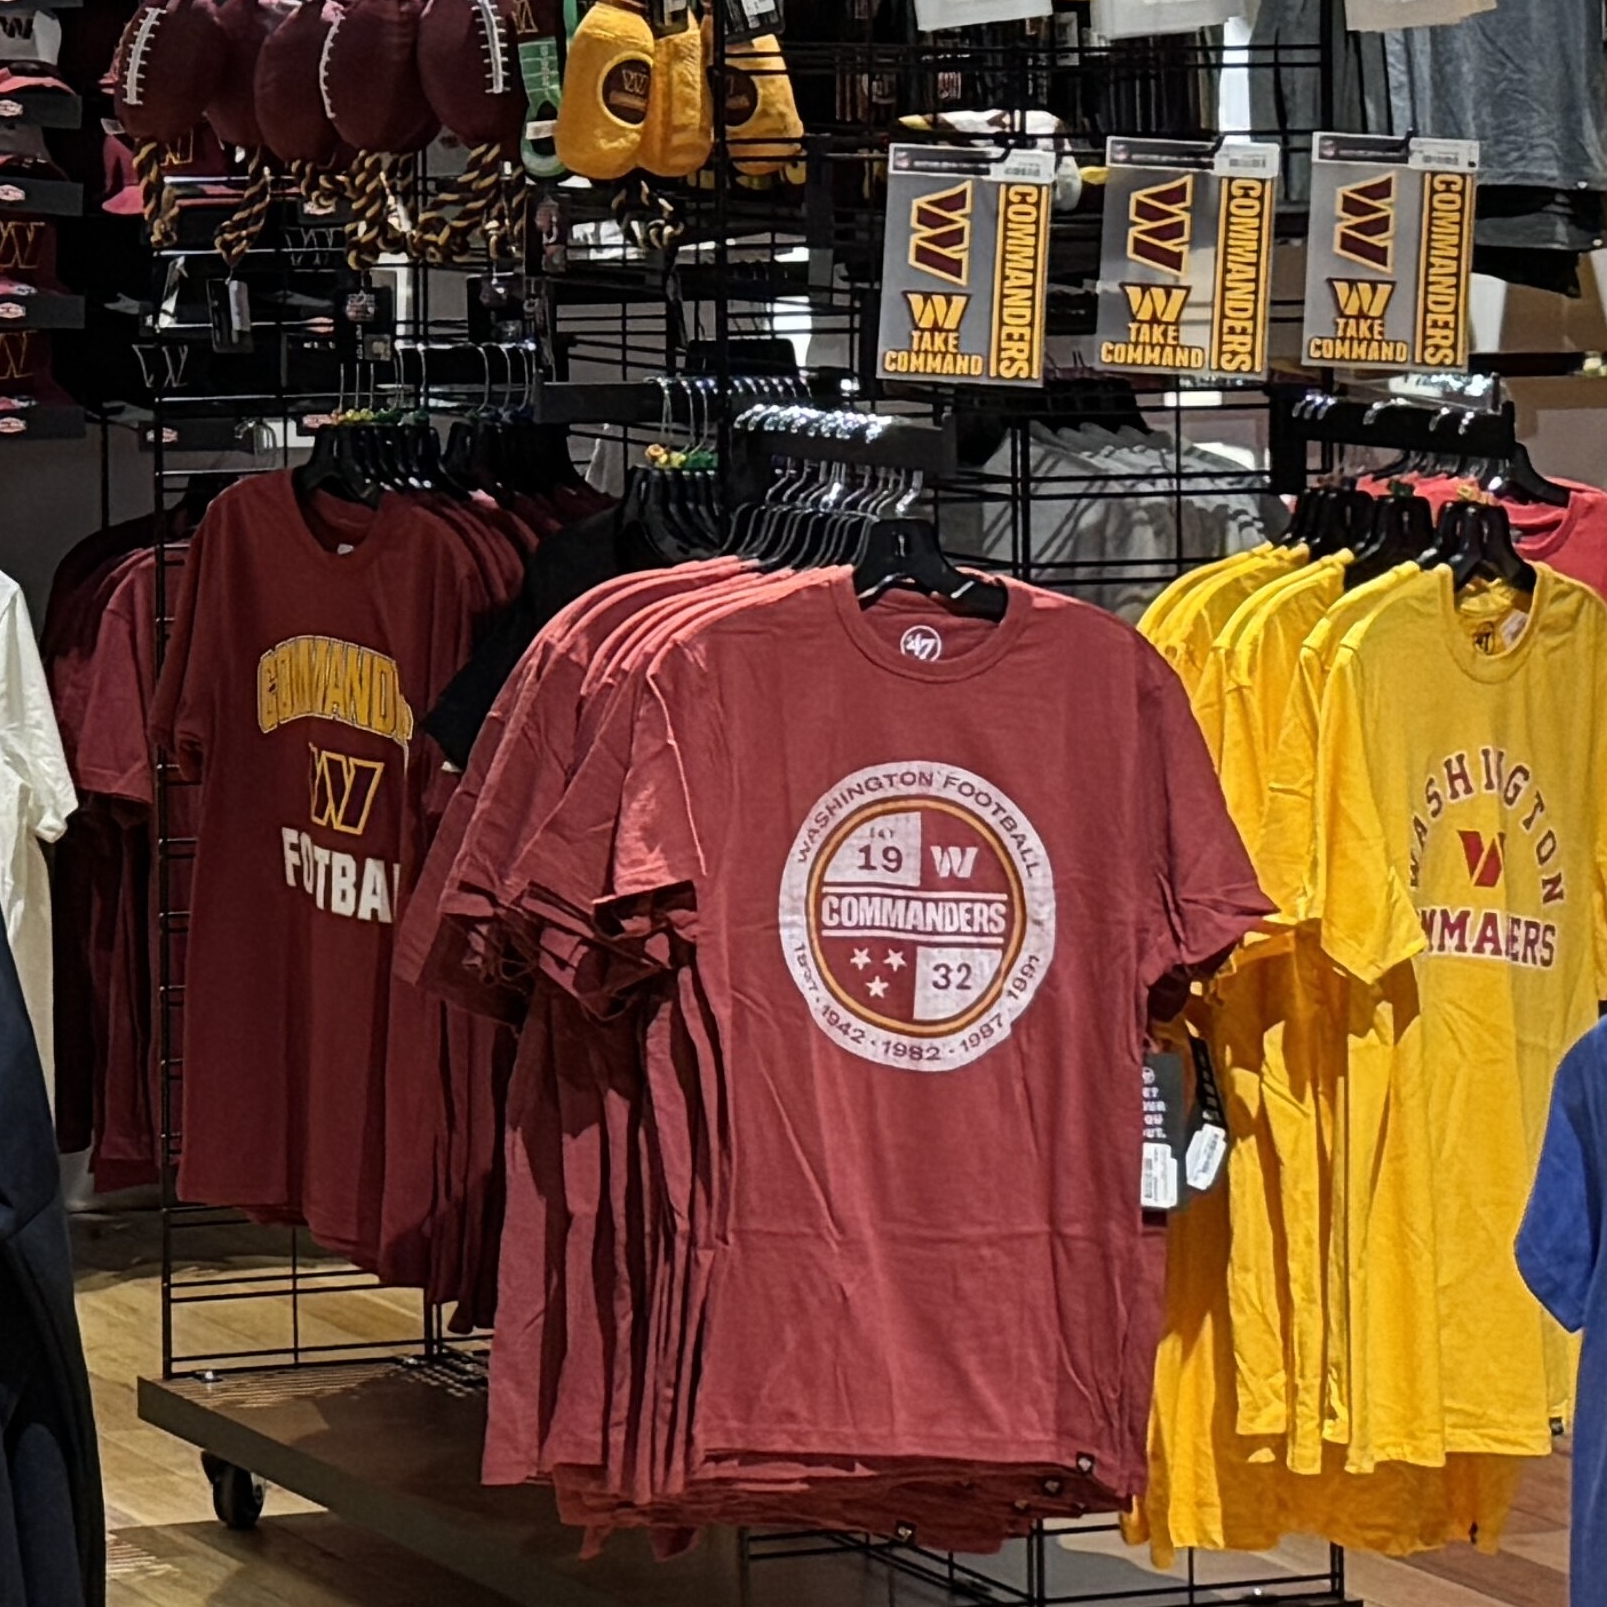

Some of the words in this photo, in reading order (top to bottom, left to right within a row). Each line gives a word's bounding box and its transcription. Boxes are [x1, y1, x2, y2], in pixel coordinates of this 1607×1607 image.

[908, 180, 972, 286] W
[1127, 174, 1192, 278] W
[1333, 171, 1397, 275] W
[999, 184, 1038, 379] COMMANDERS
[1221, 179, 1262, 372] COMMANDERS
[1424, 174, 1463, 365] COMMANDERS
[903, 291, 970, 329] W
[1123, 284, 1191, 322] W
[1328, 278, 1396, 318] W
[911, 330, 959, 353] TAKE
[1129, 323, 1178, 344] TAKE
[1336, 318, 1384, 339] TAKE
[884, 351, 983, 376] COMMAND
[1101, 342, 1204, 369] COMMAND
[1309, 338, 1408, 362] COMMAND
[904, 630, 938, 660] 47
[798, 771, 933, 864] WASHINGTON
[944, 776, 1040, 878] FOOTBALL
[856, 845, 903, 873] 19
[930, 846, 978, 878] W
[821, 896, 1007, 934] COMMANDERS
[932, 963, 973, 991] 32
[821, 1004, 867, 1044] 1942
[883, 1040, 941, 1062] 1982
[960, 1015, 1004, 1052] 1987
[1006, 955, 1041, 1001] 1991
